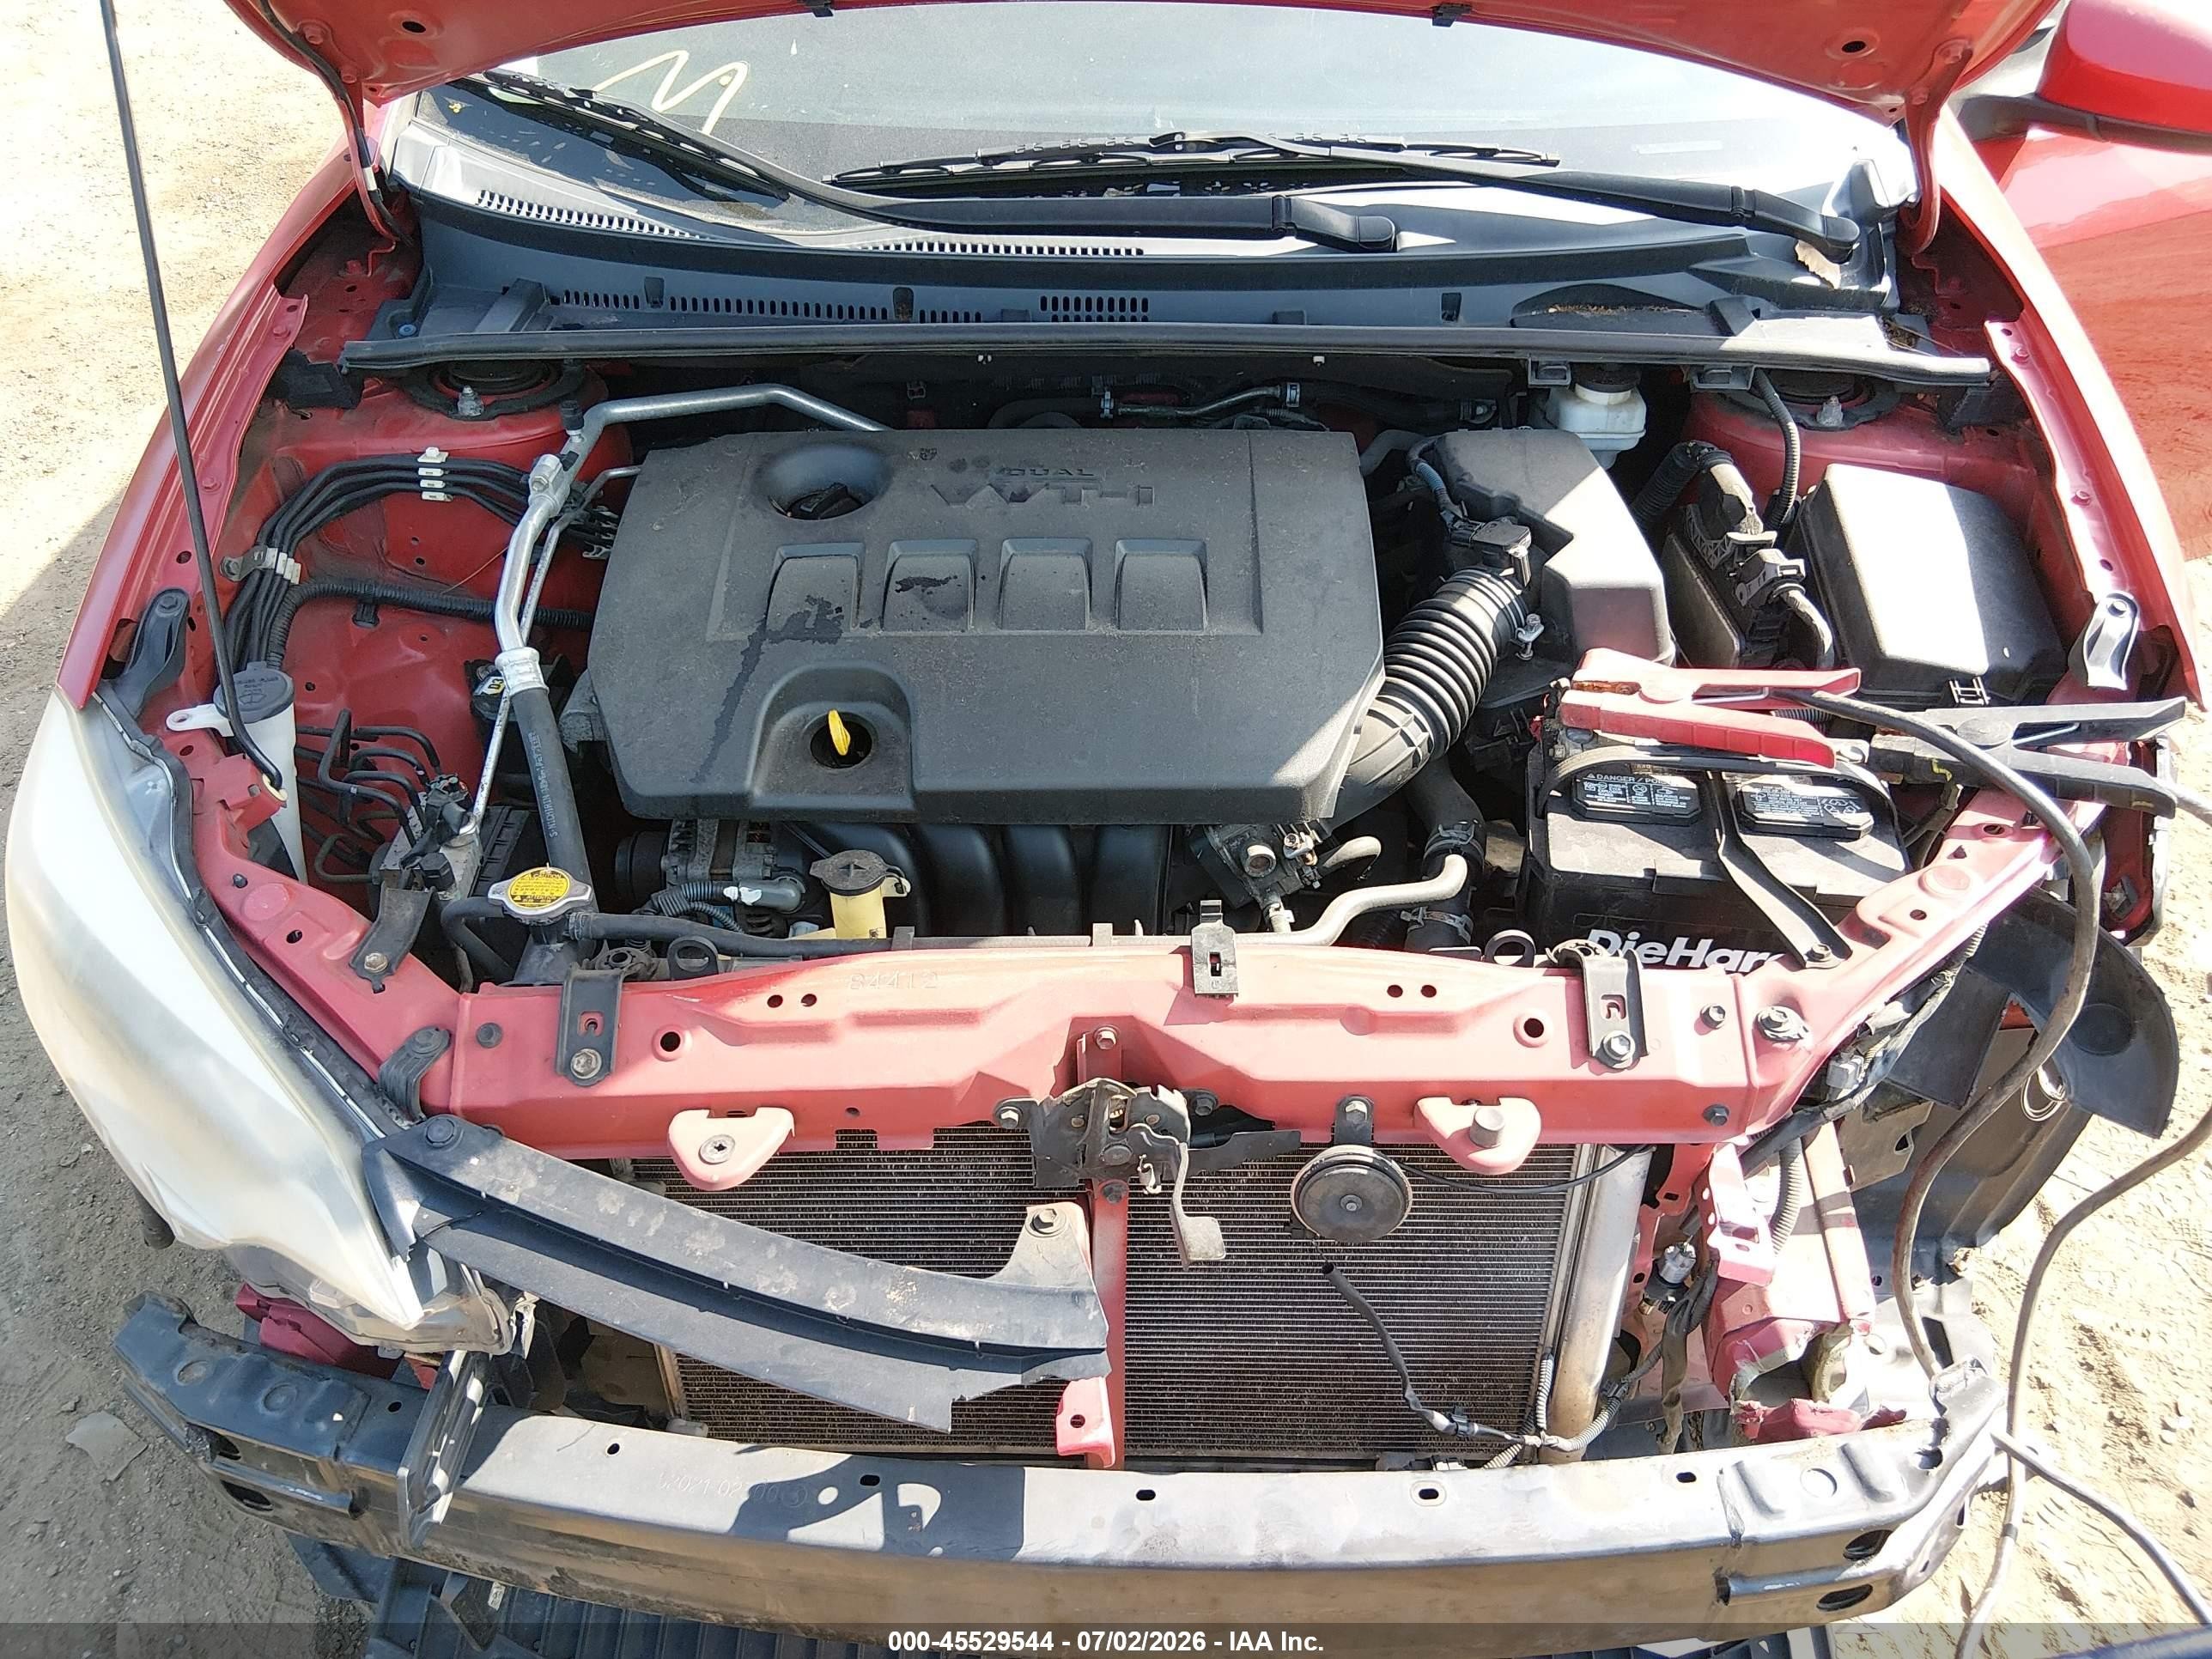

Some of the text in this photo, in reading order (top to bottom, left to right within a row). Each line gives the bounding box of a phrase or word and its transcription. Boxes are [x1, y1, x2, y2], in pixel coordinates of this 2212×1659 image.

[1001, 468, 1095, 477] DUAL
[1596, 774, 1636, 782] DANGER
[1586, 928, 1786, 973] DieHar
